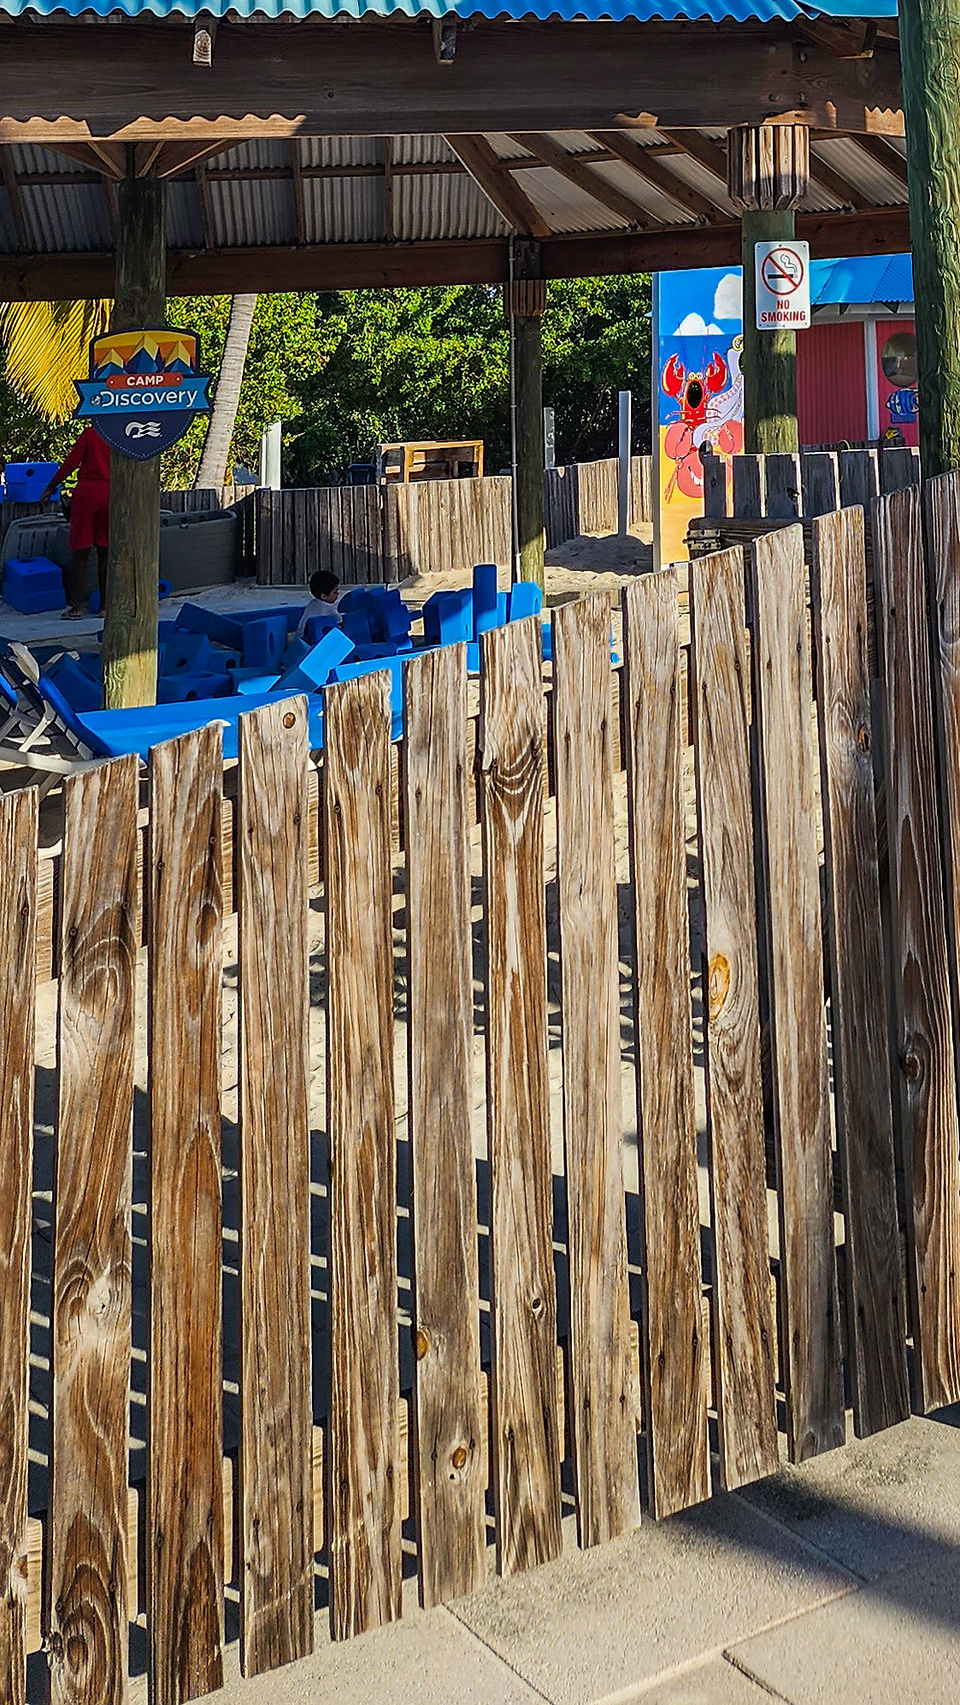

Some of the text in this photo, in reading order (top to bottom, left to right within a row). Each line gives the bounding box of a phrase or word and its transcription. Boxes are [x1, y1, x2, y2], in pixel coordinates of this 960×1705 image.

[776, 299, 790, 310] NO
[761, 311, 806, 322] SMOKING
[126, 375, 164, 386] CAMP
[100, 390, 198, 408] Discovery
